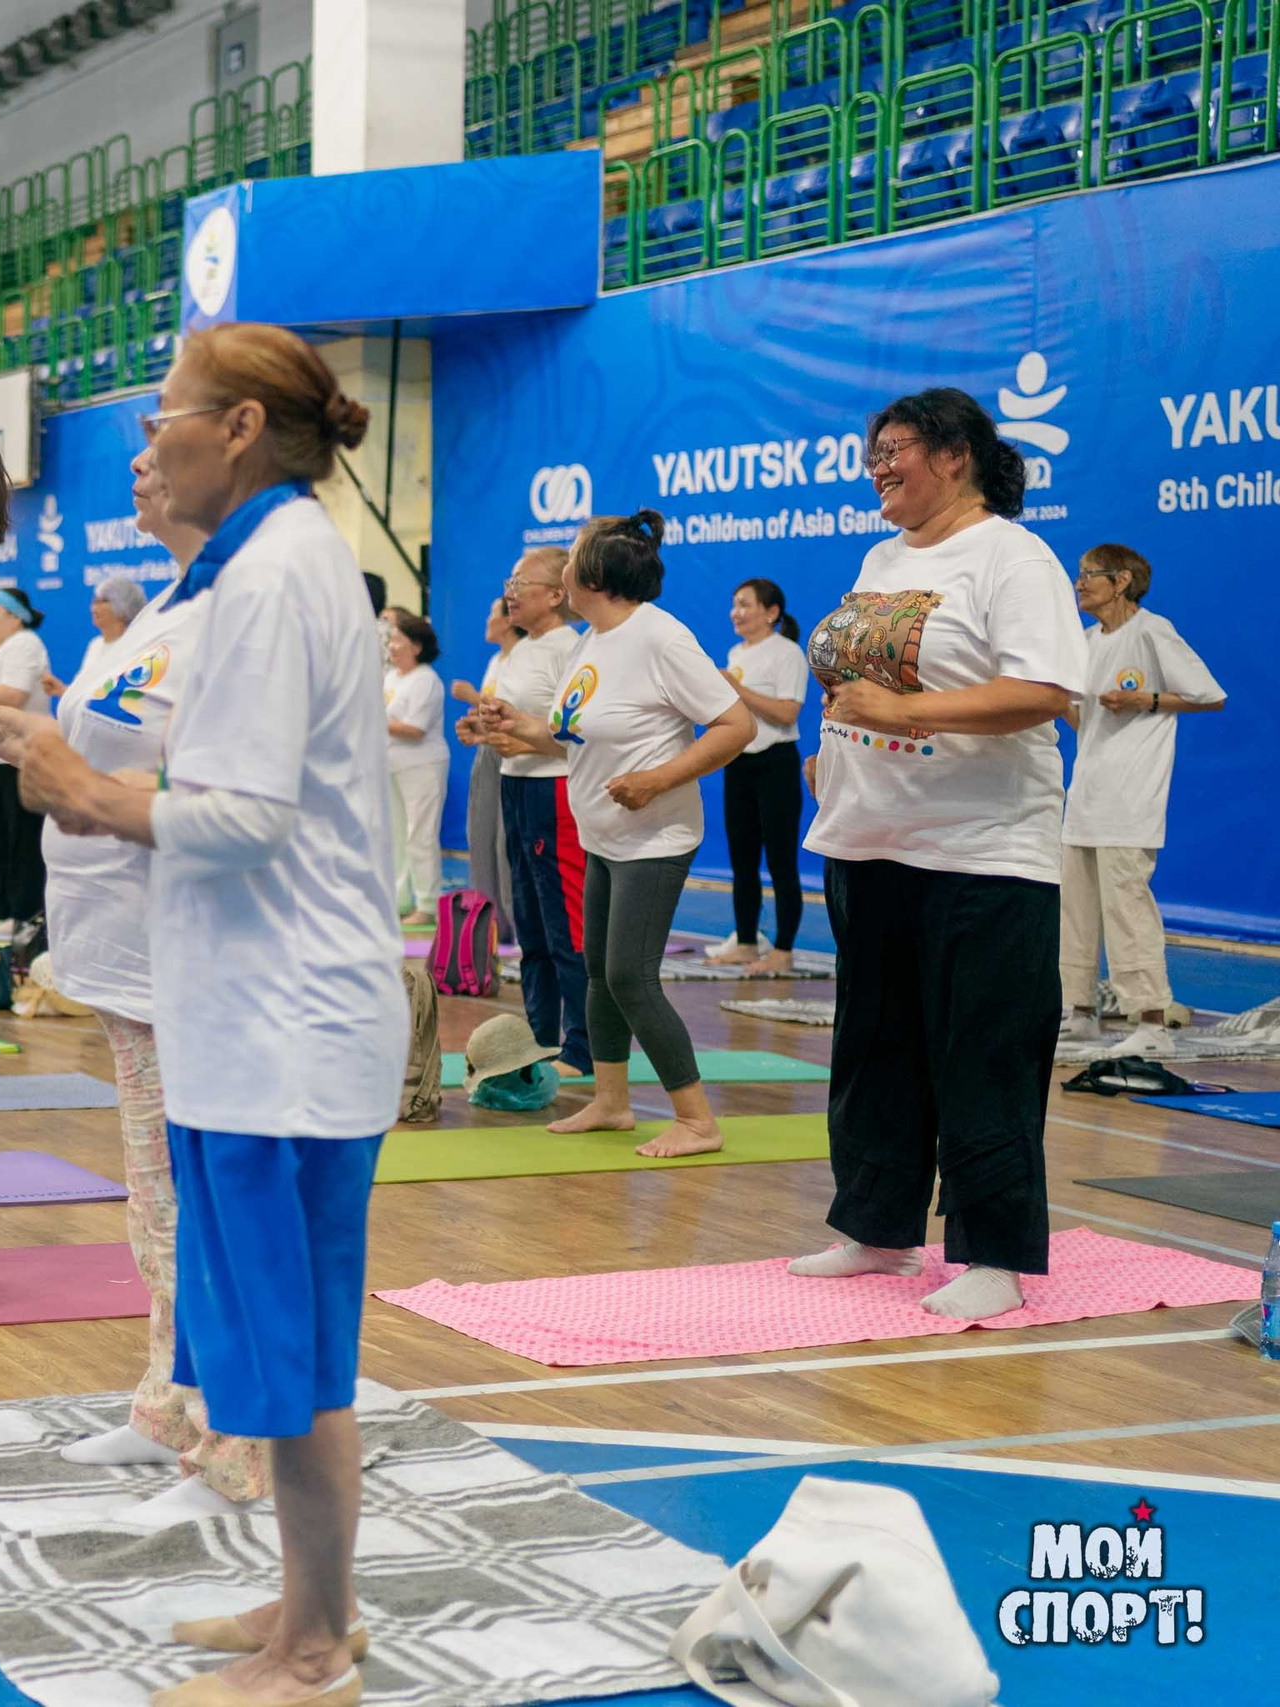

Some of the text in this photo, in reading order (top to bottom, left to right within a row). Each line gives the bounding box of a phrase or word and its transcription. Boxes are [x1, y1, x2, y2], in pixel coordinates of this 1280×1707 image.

[652, 432, 874, 497] YAKUTSK 20
[1157, 475, 1209, 513] 8th
[661, 516, 684, 546] th
[685, 511, 764, 544] Children
[766, 507, 789, 540] of
[789, 506, 835, 538] Asia
